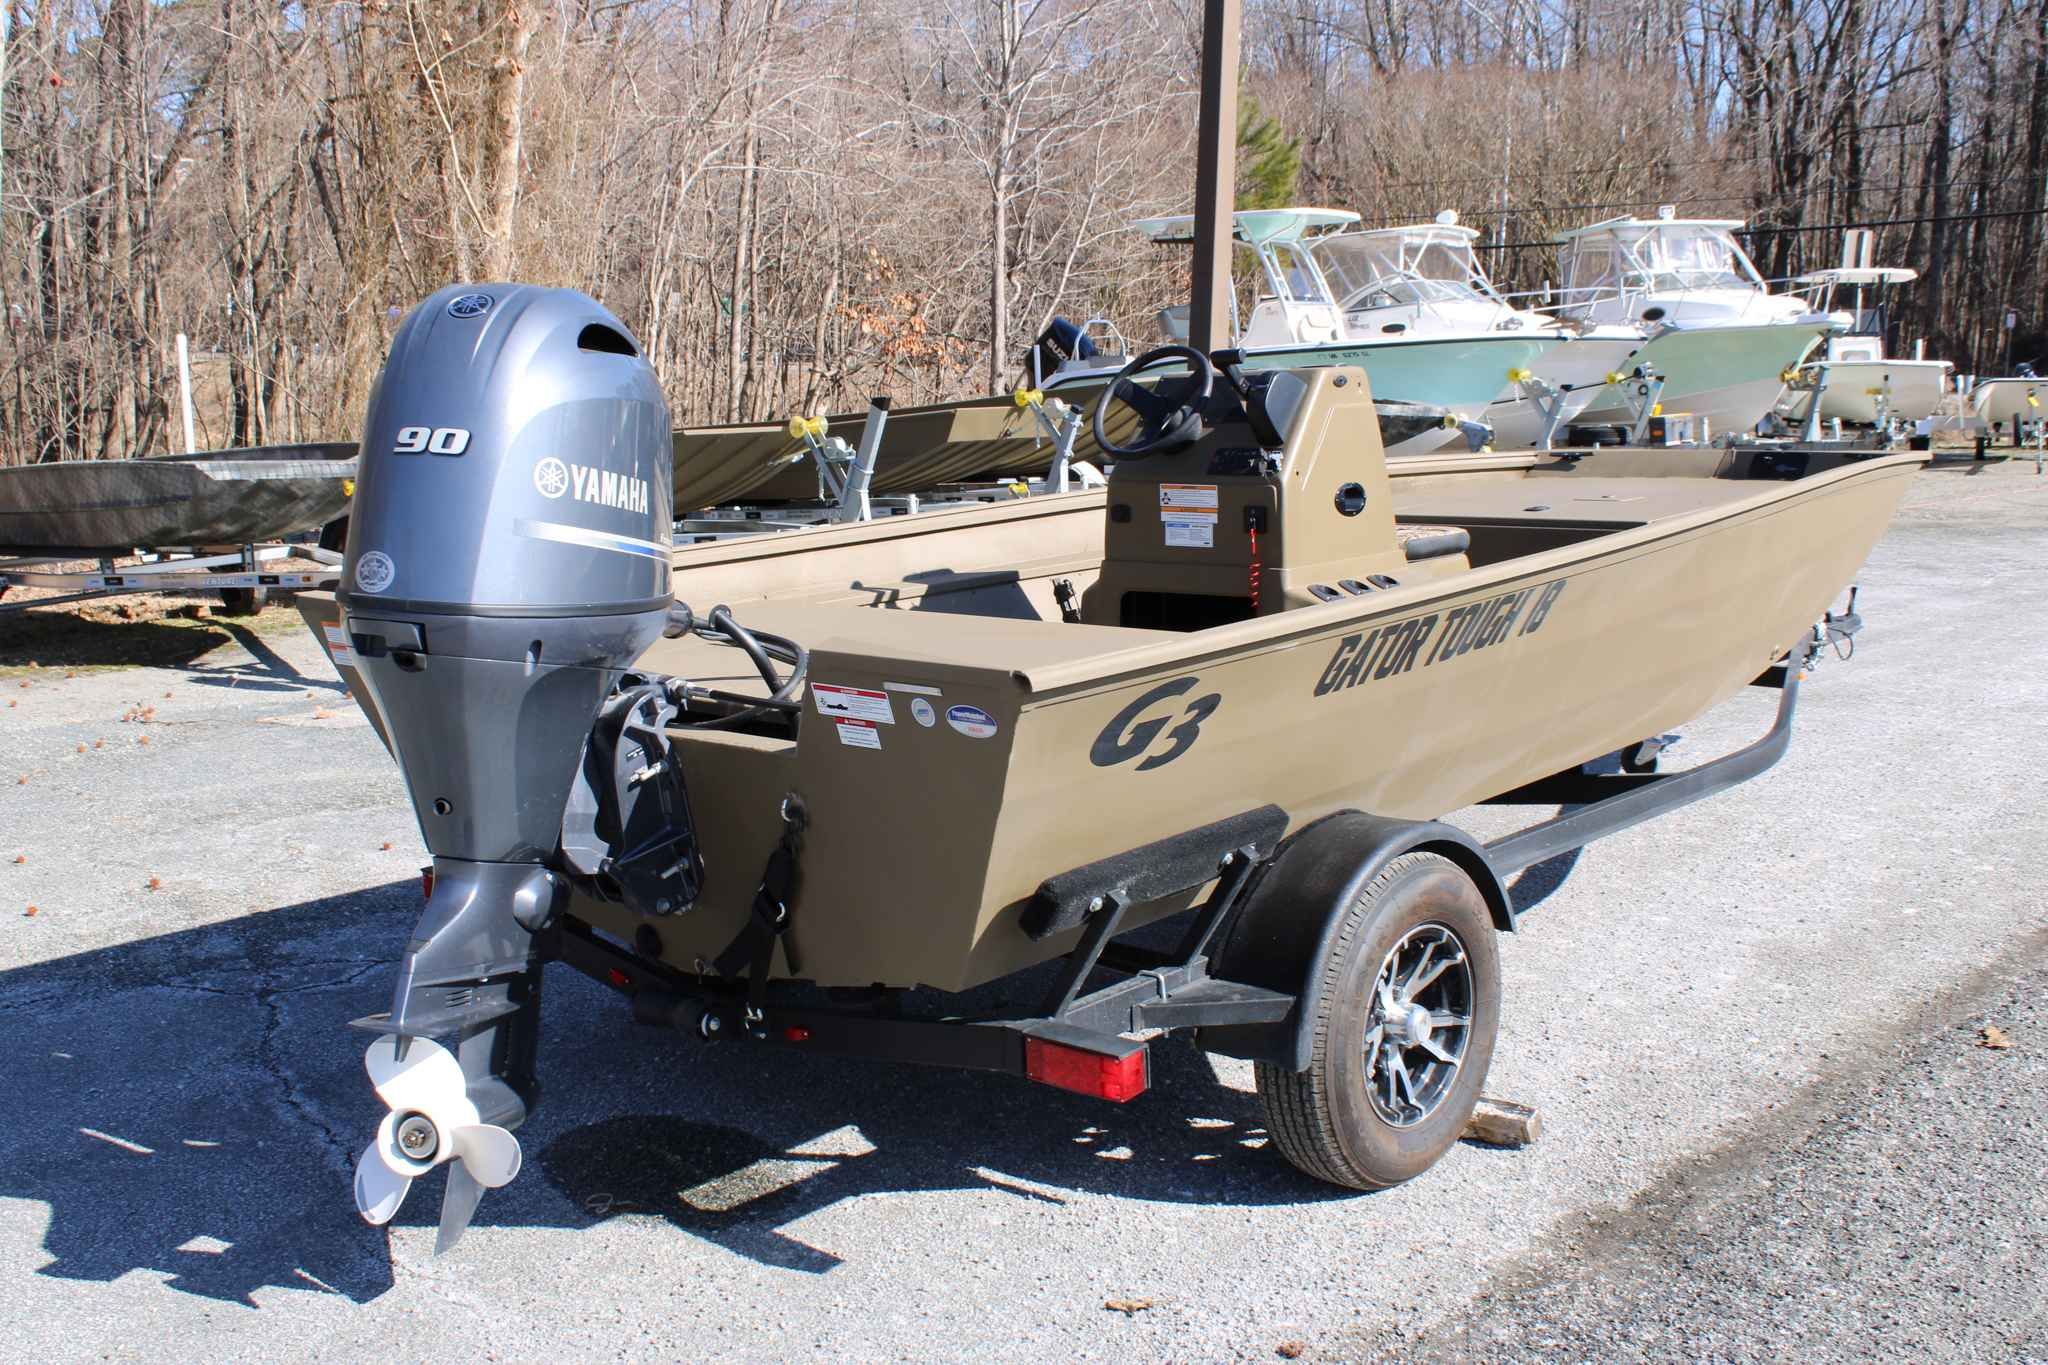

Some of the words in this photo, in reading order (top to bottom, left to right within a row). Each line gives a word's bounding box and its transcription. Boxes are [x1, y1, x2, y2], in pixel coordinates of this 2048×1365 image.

[393, 426, 471, 456] 90
[571, 463, 649, 514] YAMAHA
[1313, 614, 1439, 698] GATOR
[1423, 588, 1537, 667] TOUGH
[1517, 580, 1568, 638] 18
[1089, 676, 1222, 771] G3
